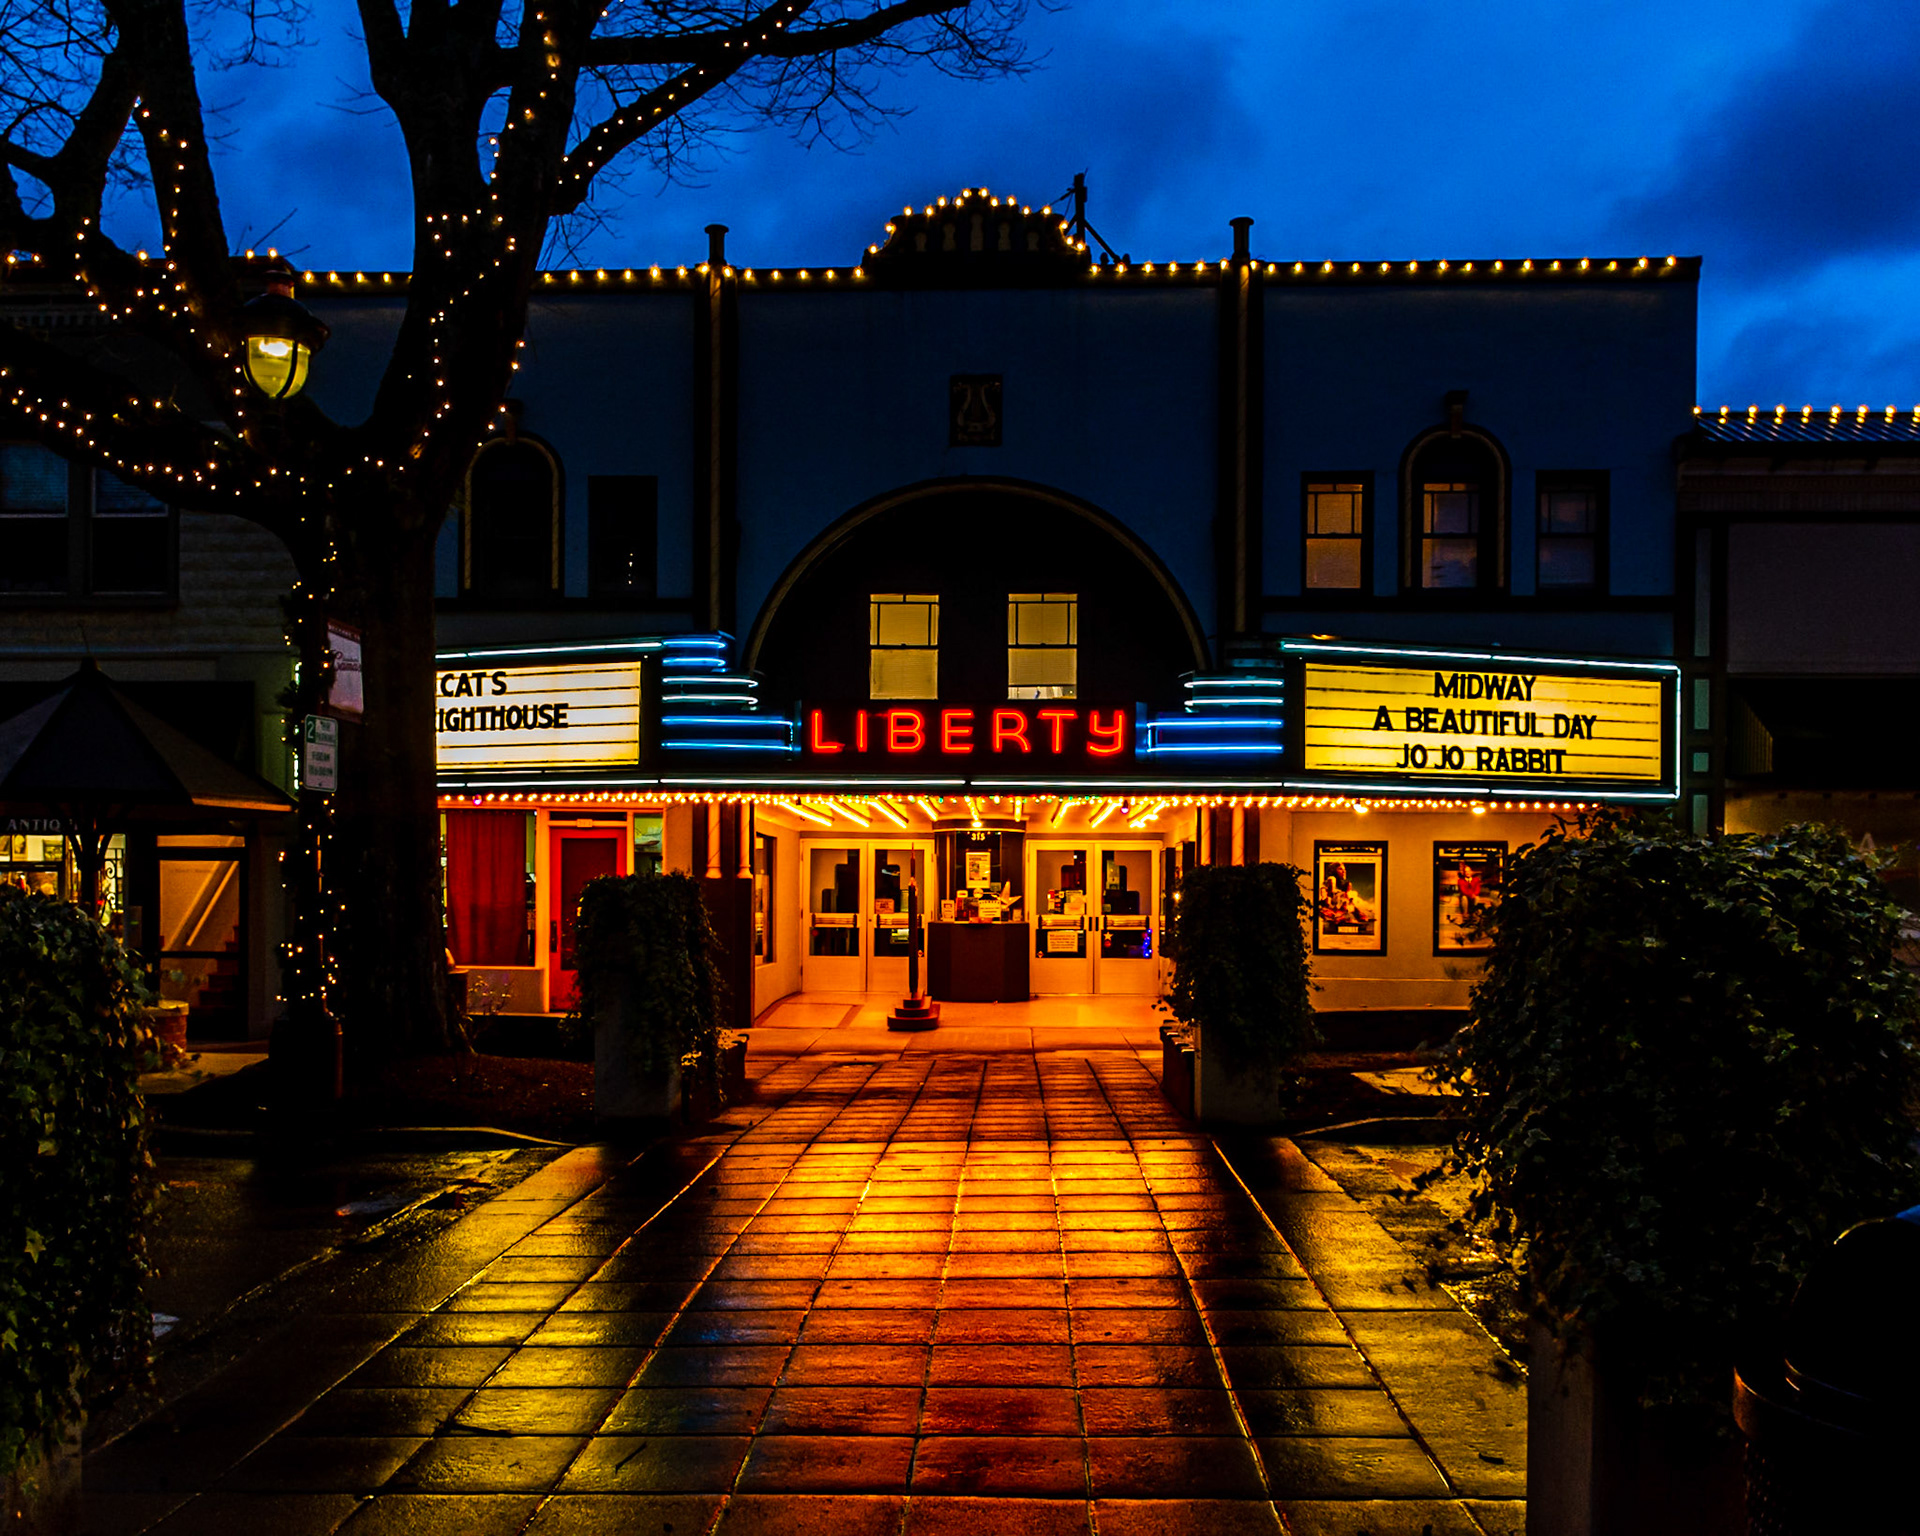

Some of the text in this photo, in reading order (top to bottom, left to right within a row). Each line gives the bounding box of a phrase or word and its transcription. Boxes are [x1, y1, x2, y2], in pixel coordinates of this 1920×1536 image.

[1433, 672, 1536, 701] MIDWAY
[307, 720, 315, 739] 2
[438, 703, 569, 733] IGHTHOUSE
[811, 708, 1125, 756] LIBERTY
[1372, 705, 1597, 740] A BEAUTIFUL DAY
[1396, 743, 1567, 774] JO JO RABBIT
[970, 832, 986, 841] 315
